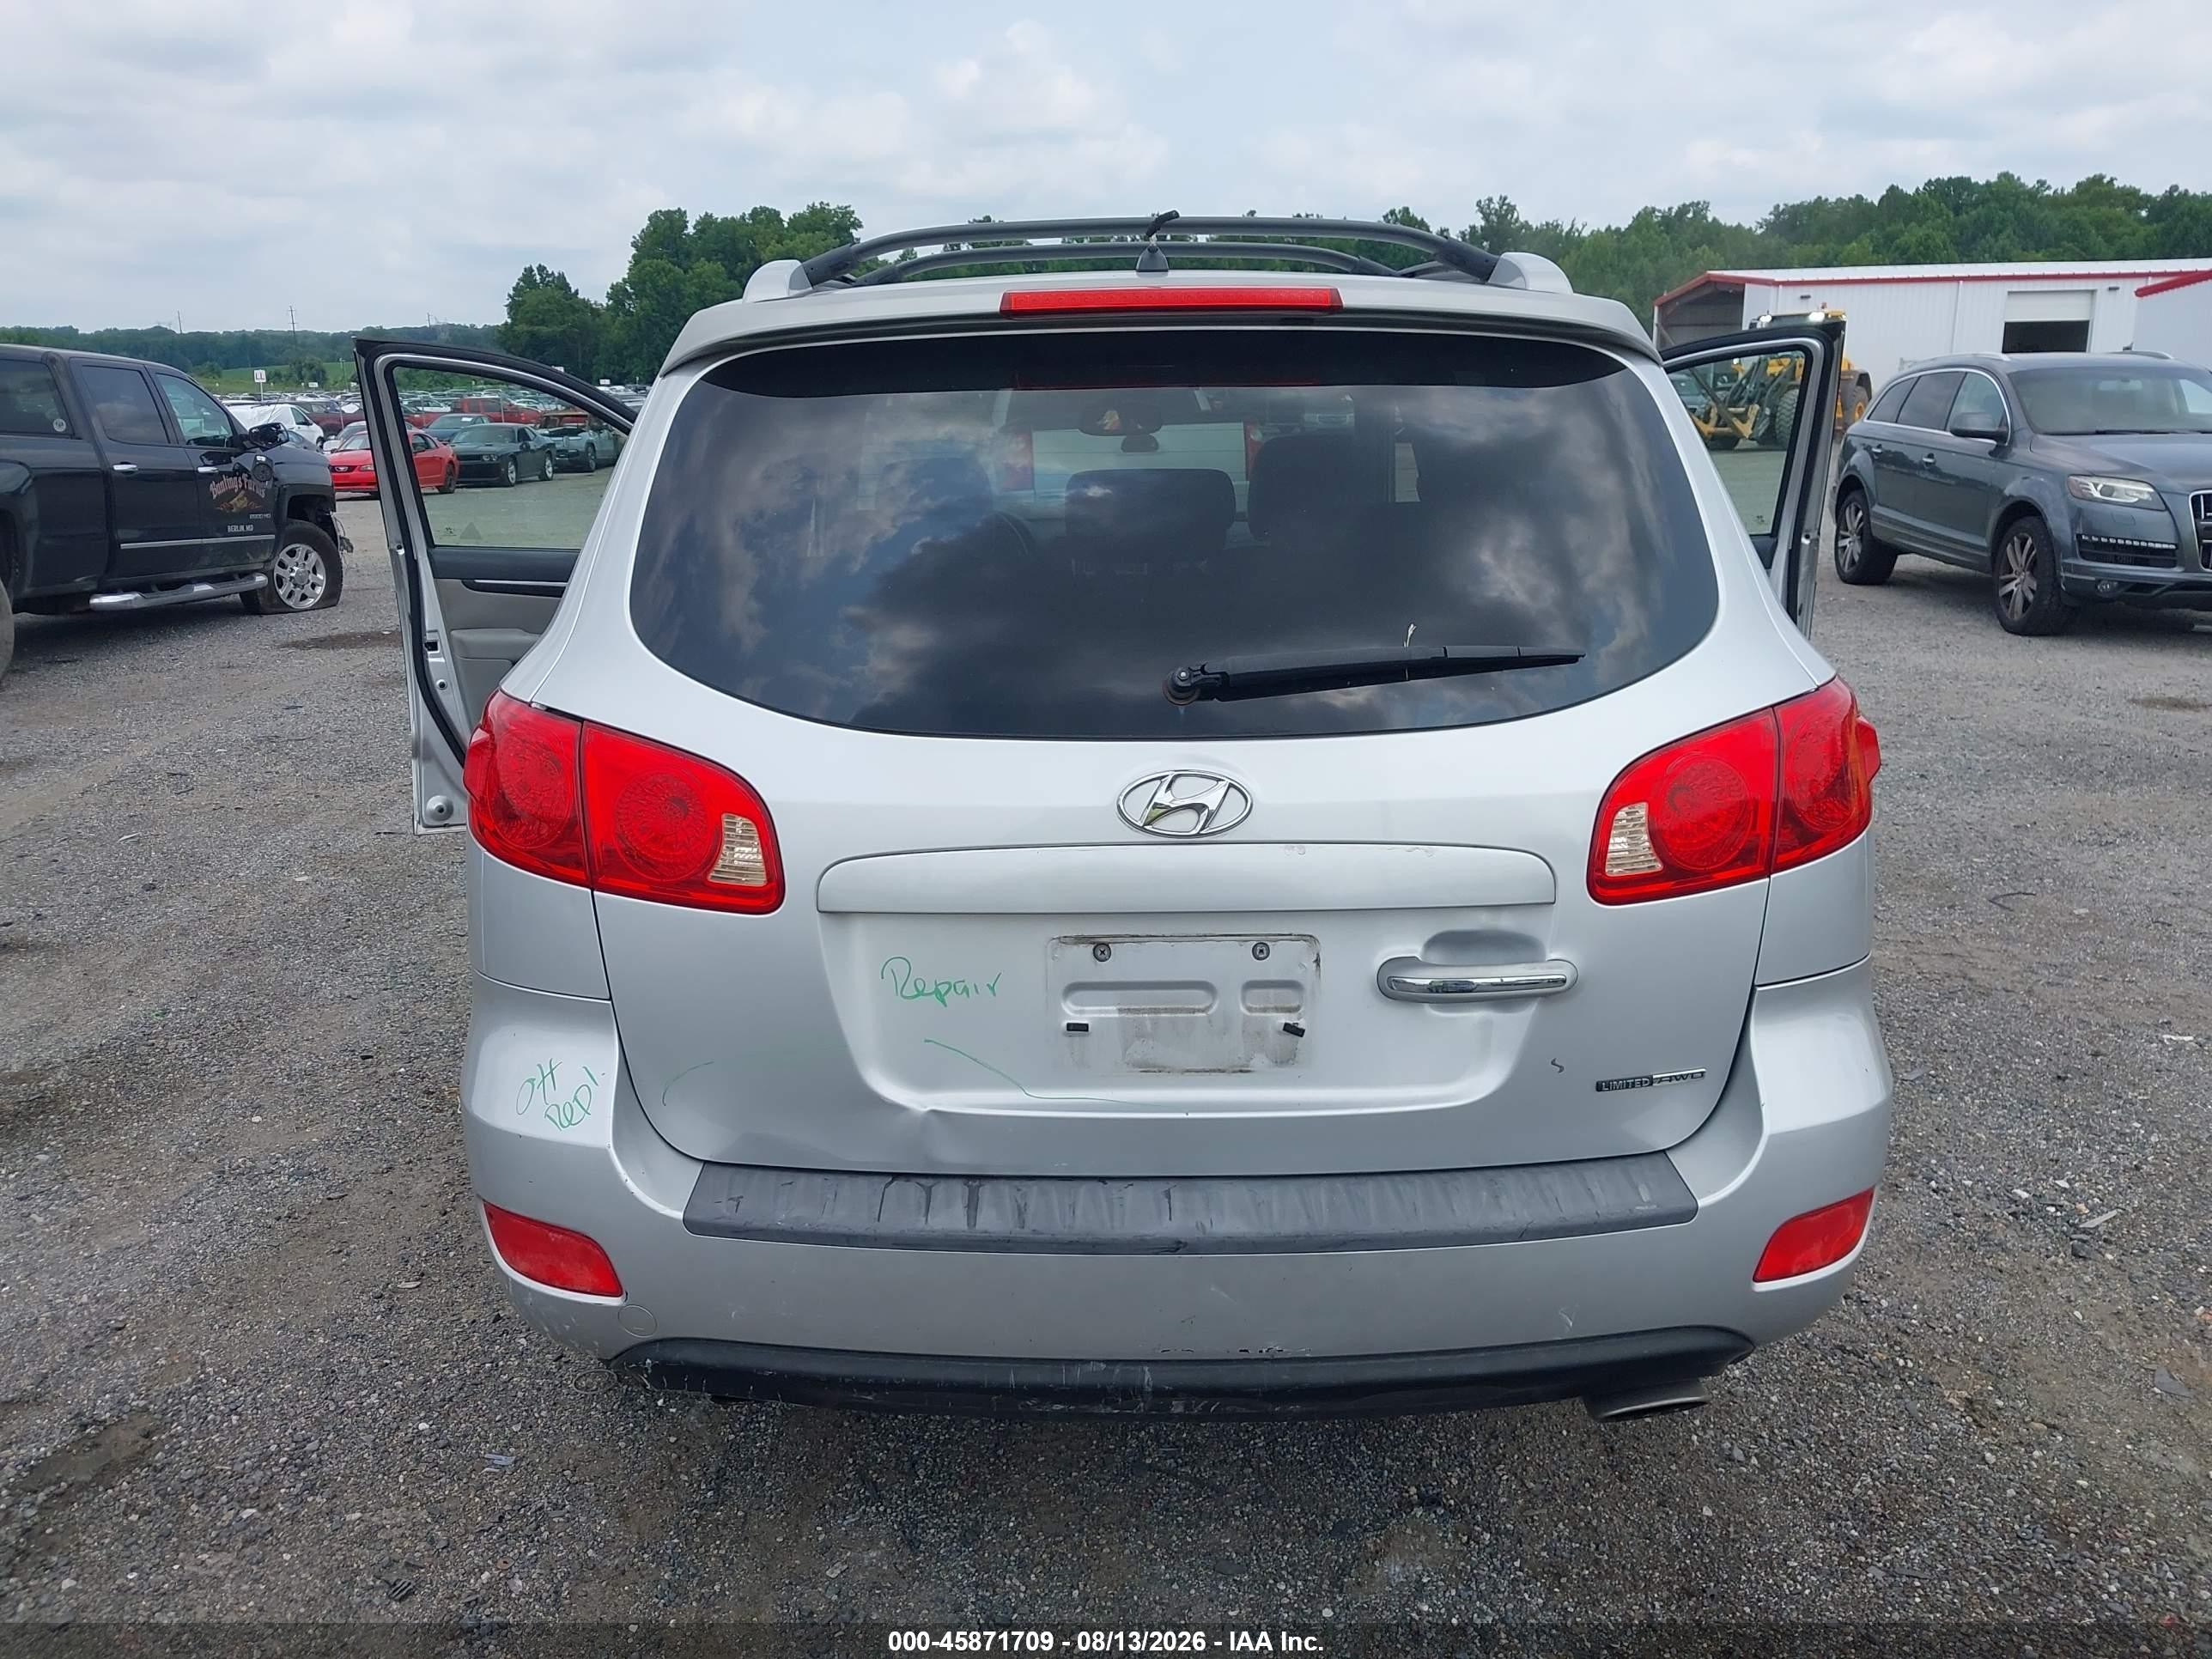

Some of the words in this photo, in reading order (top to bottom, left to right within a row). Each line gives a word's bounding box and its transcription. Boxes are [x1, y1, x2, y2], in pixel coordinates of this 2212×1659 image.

[881, 956, 1003, 1007] Repair
[1601, 1078, 1650, 1091] LIMITED
[1655, 1072, 1705, 1085] AWD
